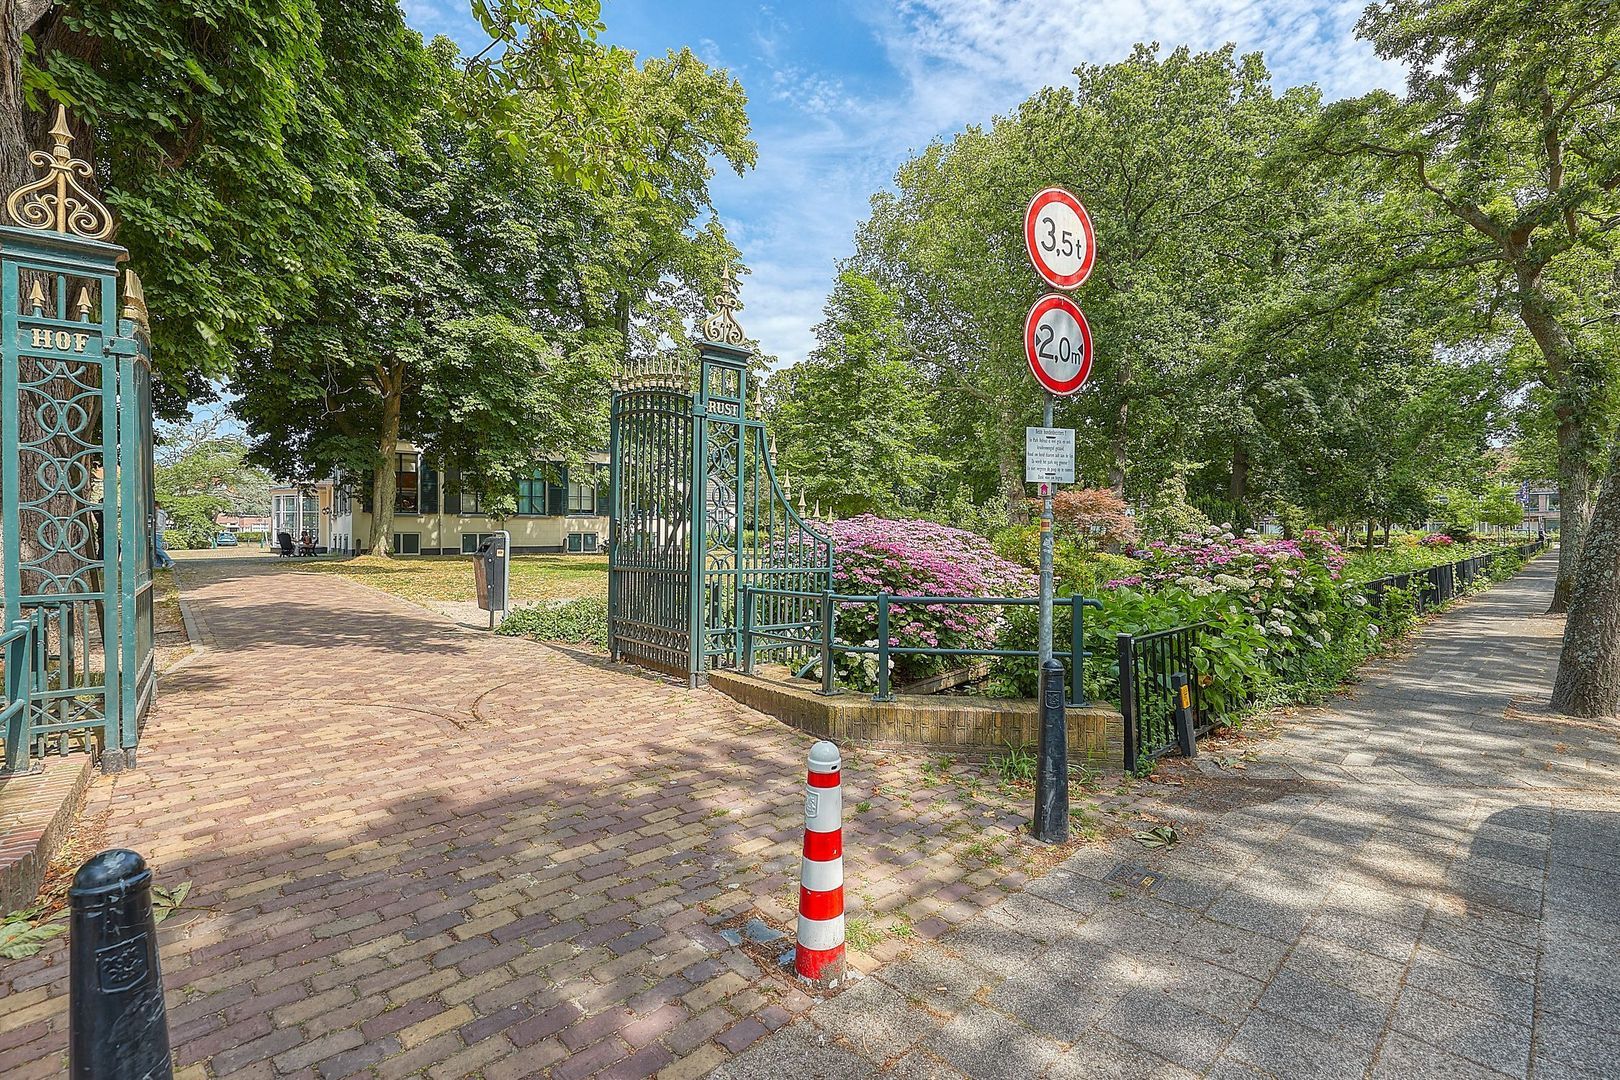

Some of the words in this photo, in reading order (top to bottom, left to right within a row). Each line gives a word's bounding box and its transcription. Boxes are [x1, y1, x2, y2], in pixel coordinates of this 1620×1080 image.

[31, 328, 90, 352] HOF
[1038, 324, 1081, 365] 2,0m
[708, 400, 739, 417] RUST
